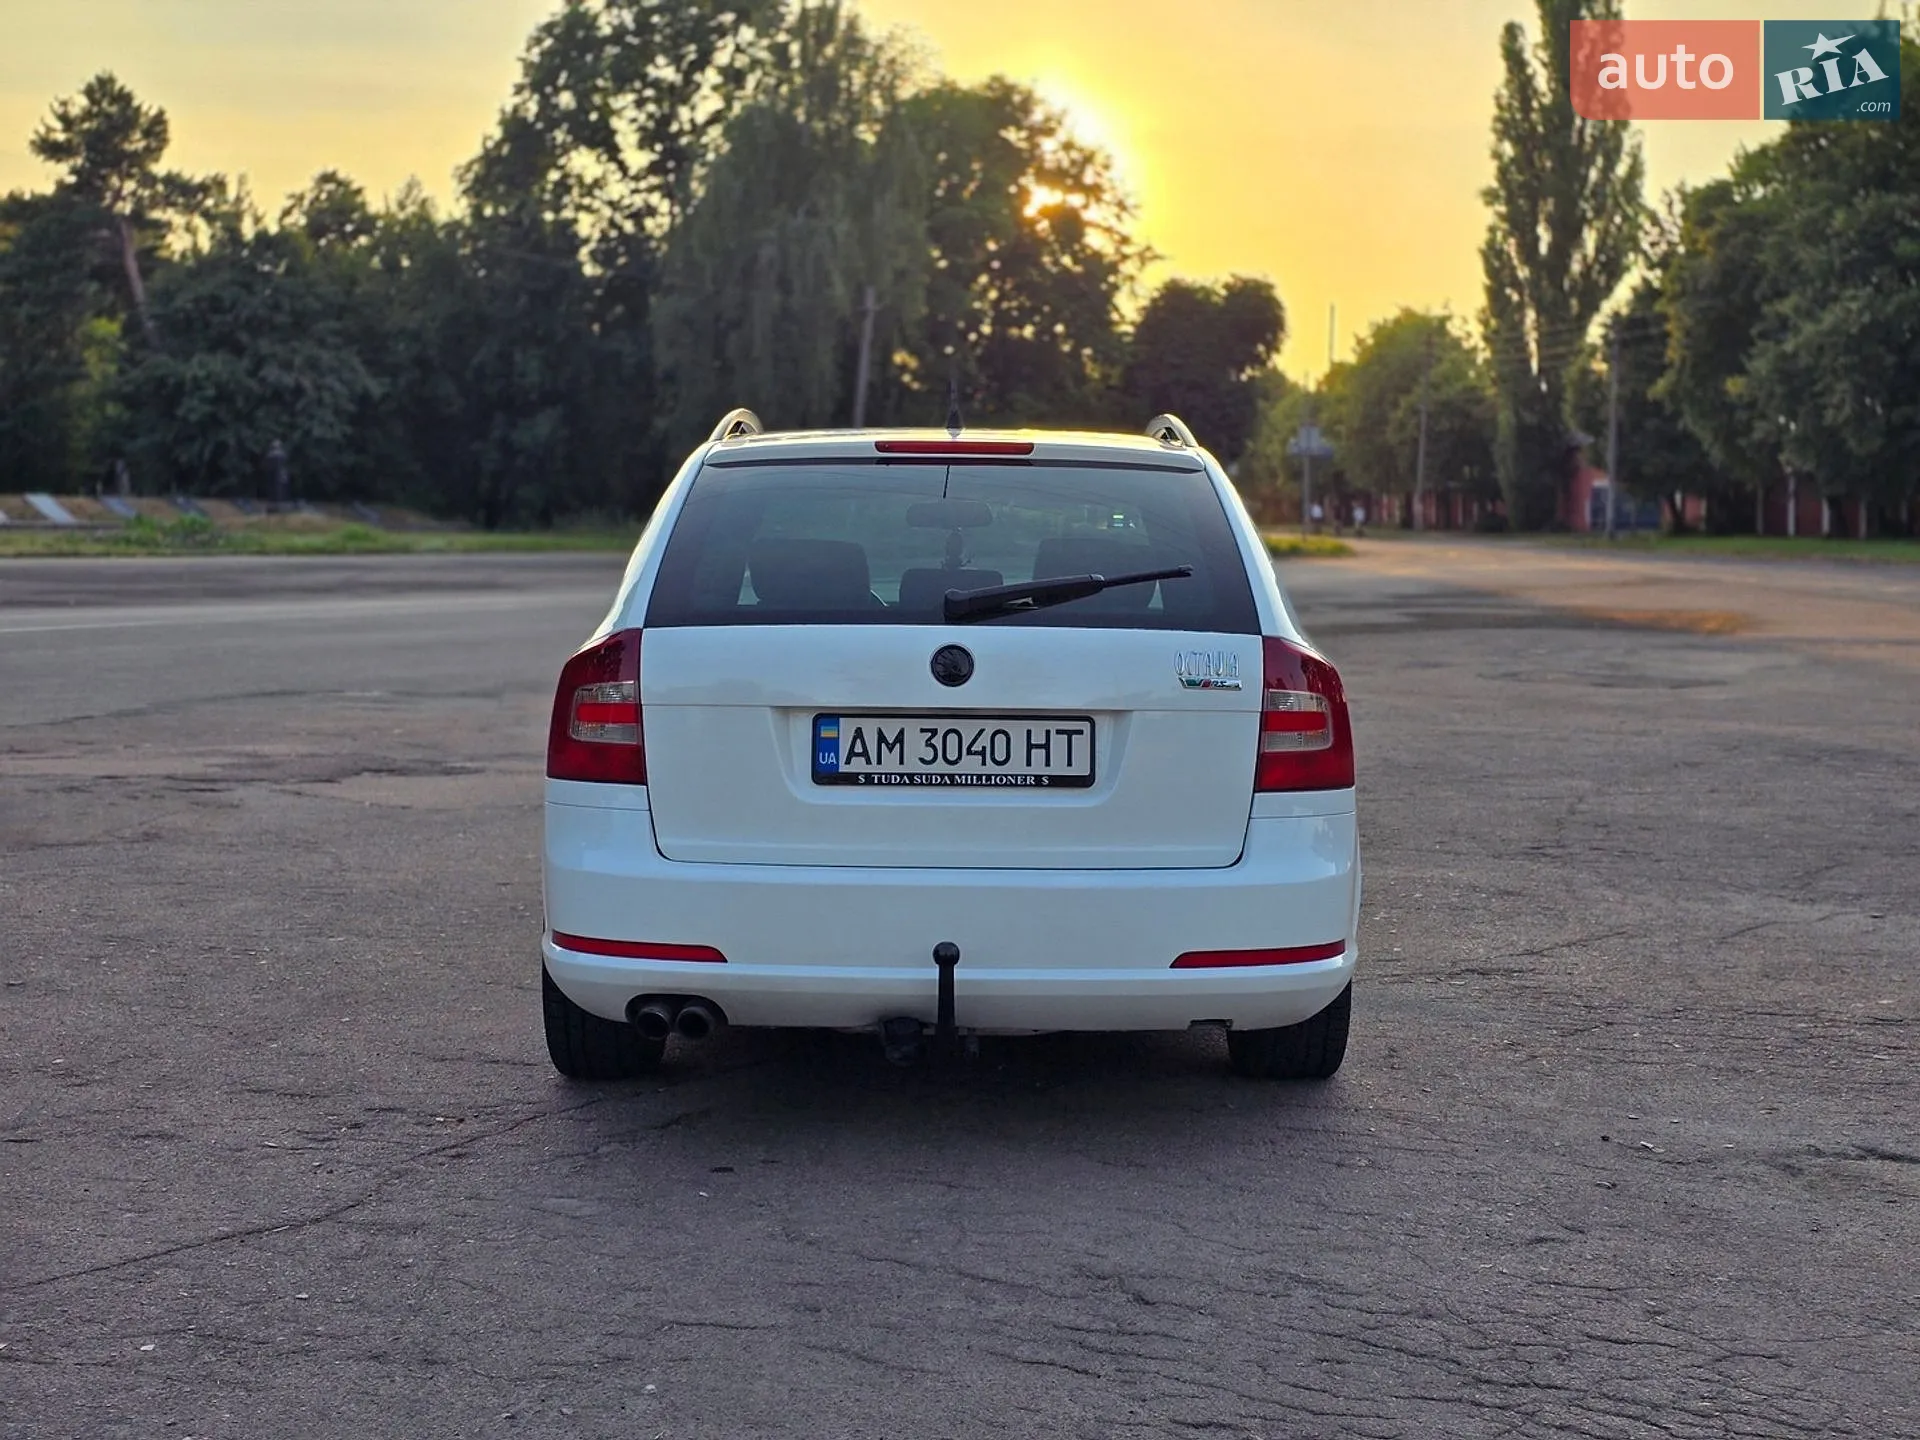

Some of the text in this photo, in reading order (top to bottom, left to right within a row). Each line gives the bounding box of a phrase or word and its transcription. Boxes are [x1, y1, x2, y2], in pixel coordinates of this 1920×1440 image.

[845, 727, 1084, 768] AM 3040 HT
[819, 753, 837, 765] UA
[872, 775, 909, 784] TUDA
[914, 775, 950, 785] SUDA
[954, 776, 1035, 785] MILLIONER
